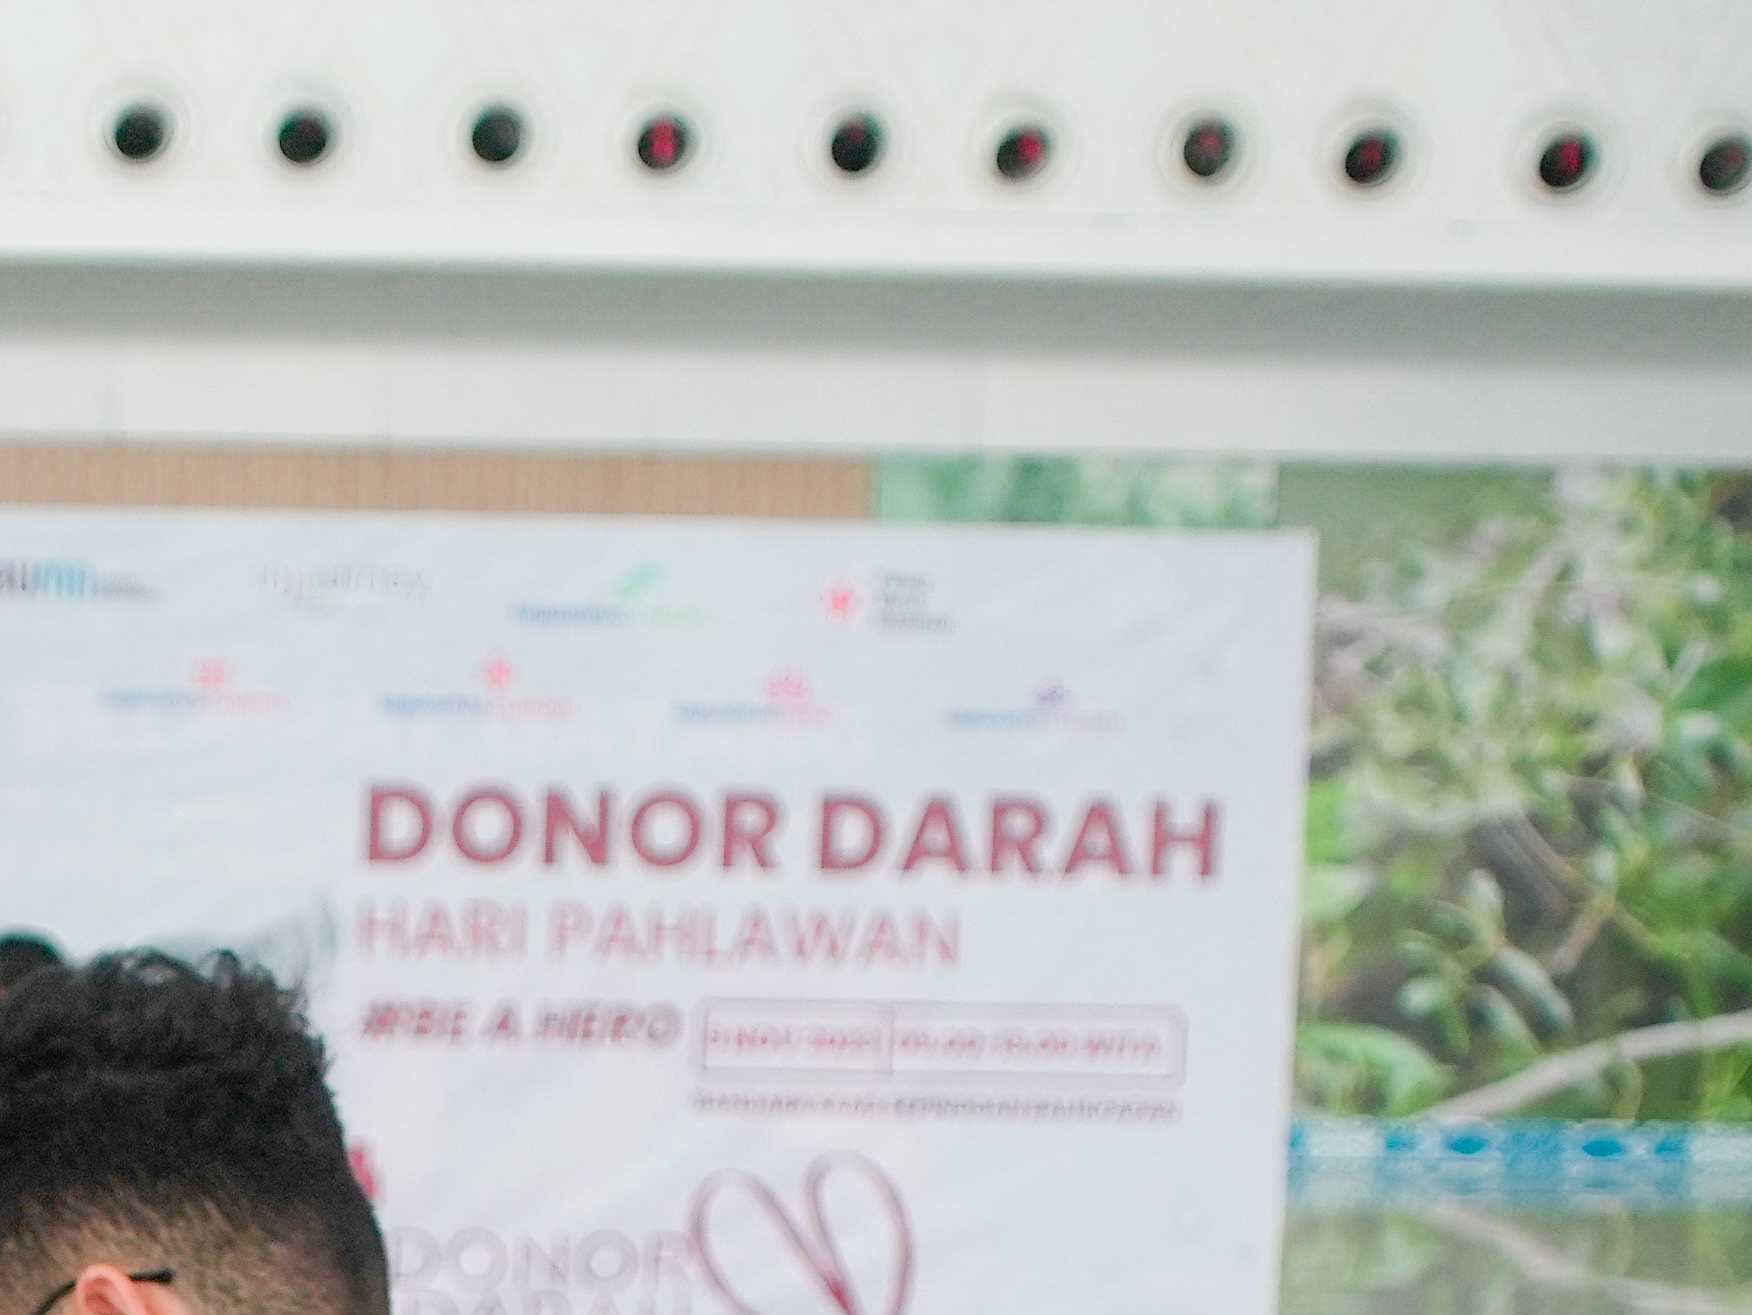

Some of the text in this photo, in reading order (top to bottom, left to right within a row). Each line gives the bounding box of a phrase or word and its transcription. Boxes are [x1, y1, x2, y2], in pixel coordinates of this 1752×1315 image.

[367, 786, 1221, 880] DONOR DARAH
[359, 899, 962, 971] HARI PAHLAWAN
[534, 999, 684, 1046] HERO
